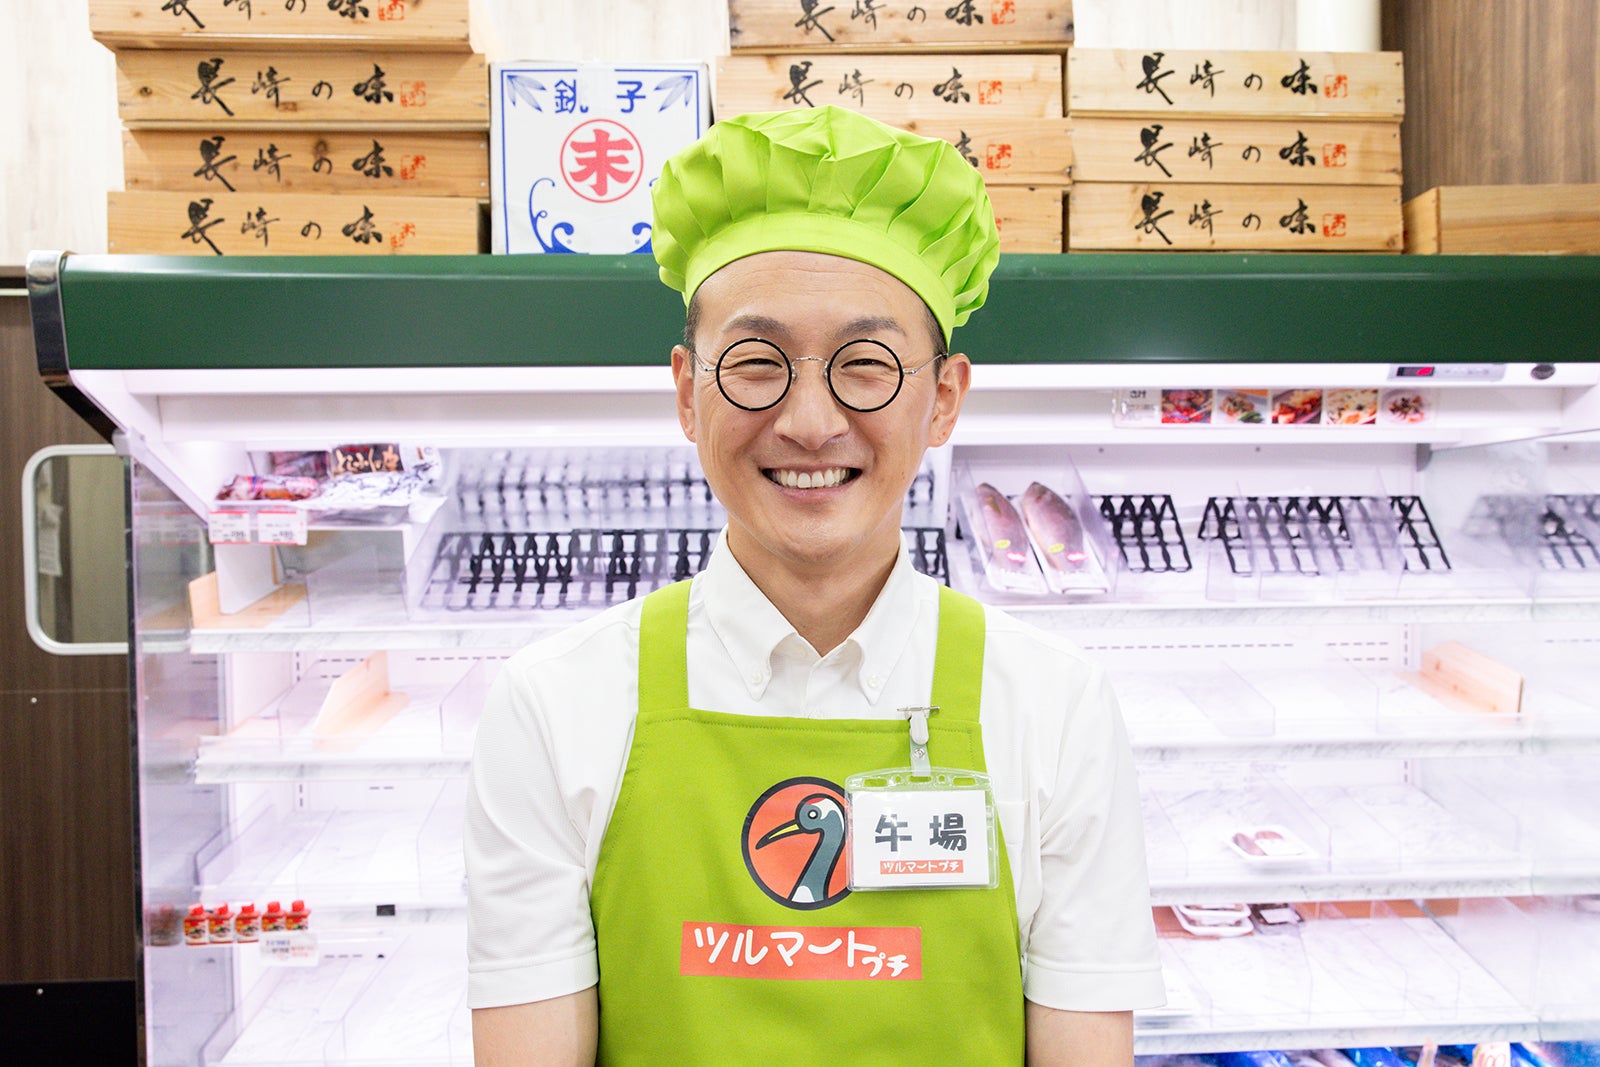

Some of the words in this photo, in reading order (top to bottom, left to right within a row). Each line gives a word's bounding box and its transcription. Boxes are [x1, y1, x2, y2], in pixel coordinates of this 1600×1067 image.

[191, 57, 394, 117] 長崎の味
[783, 61, 970, 107] 長崎の味
[1136, 52, 1318, 105] 長崎の味
[193, 136, 394, 193] 長崎の味
[1134, 124, 1316, 178] 長崎の味
[181, 198, 383, 256] 長崎の味
[1134, 191, 1316, 245] 長崎の味
[875, 813, 967, 852] 牛場
